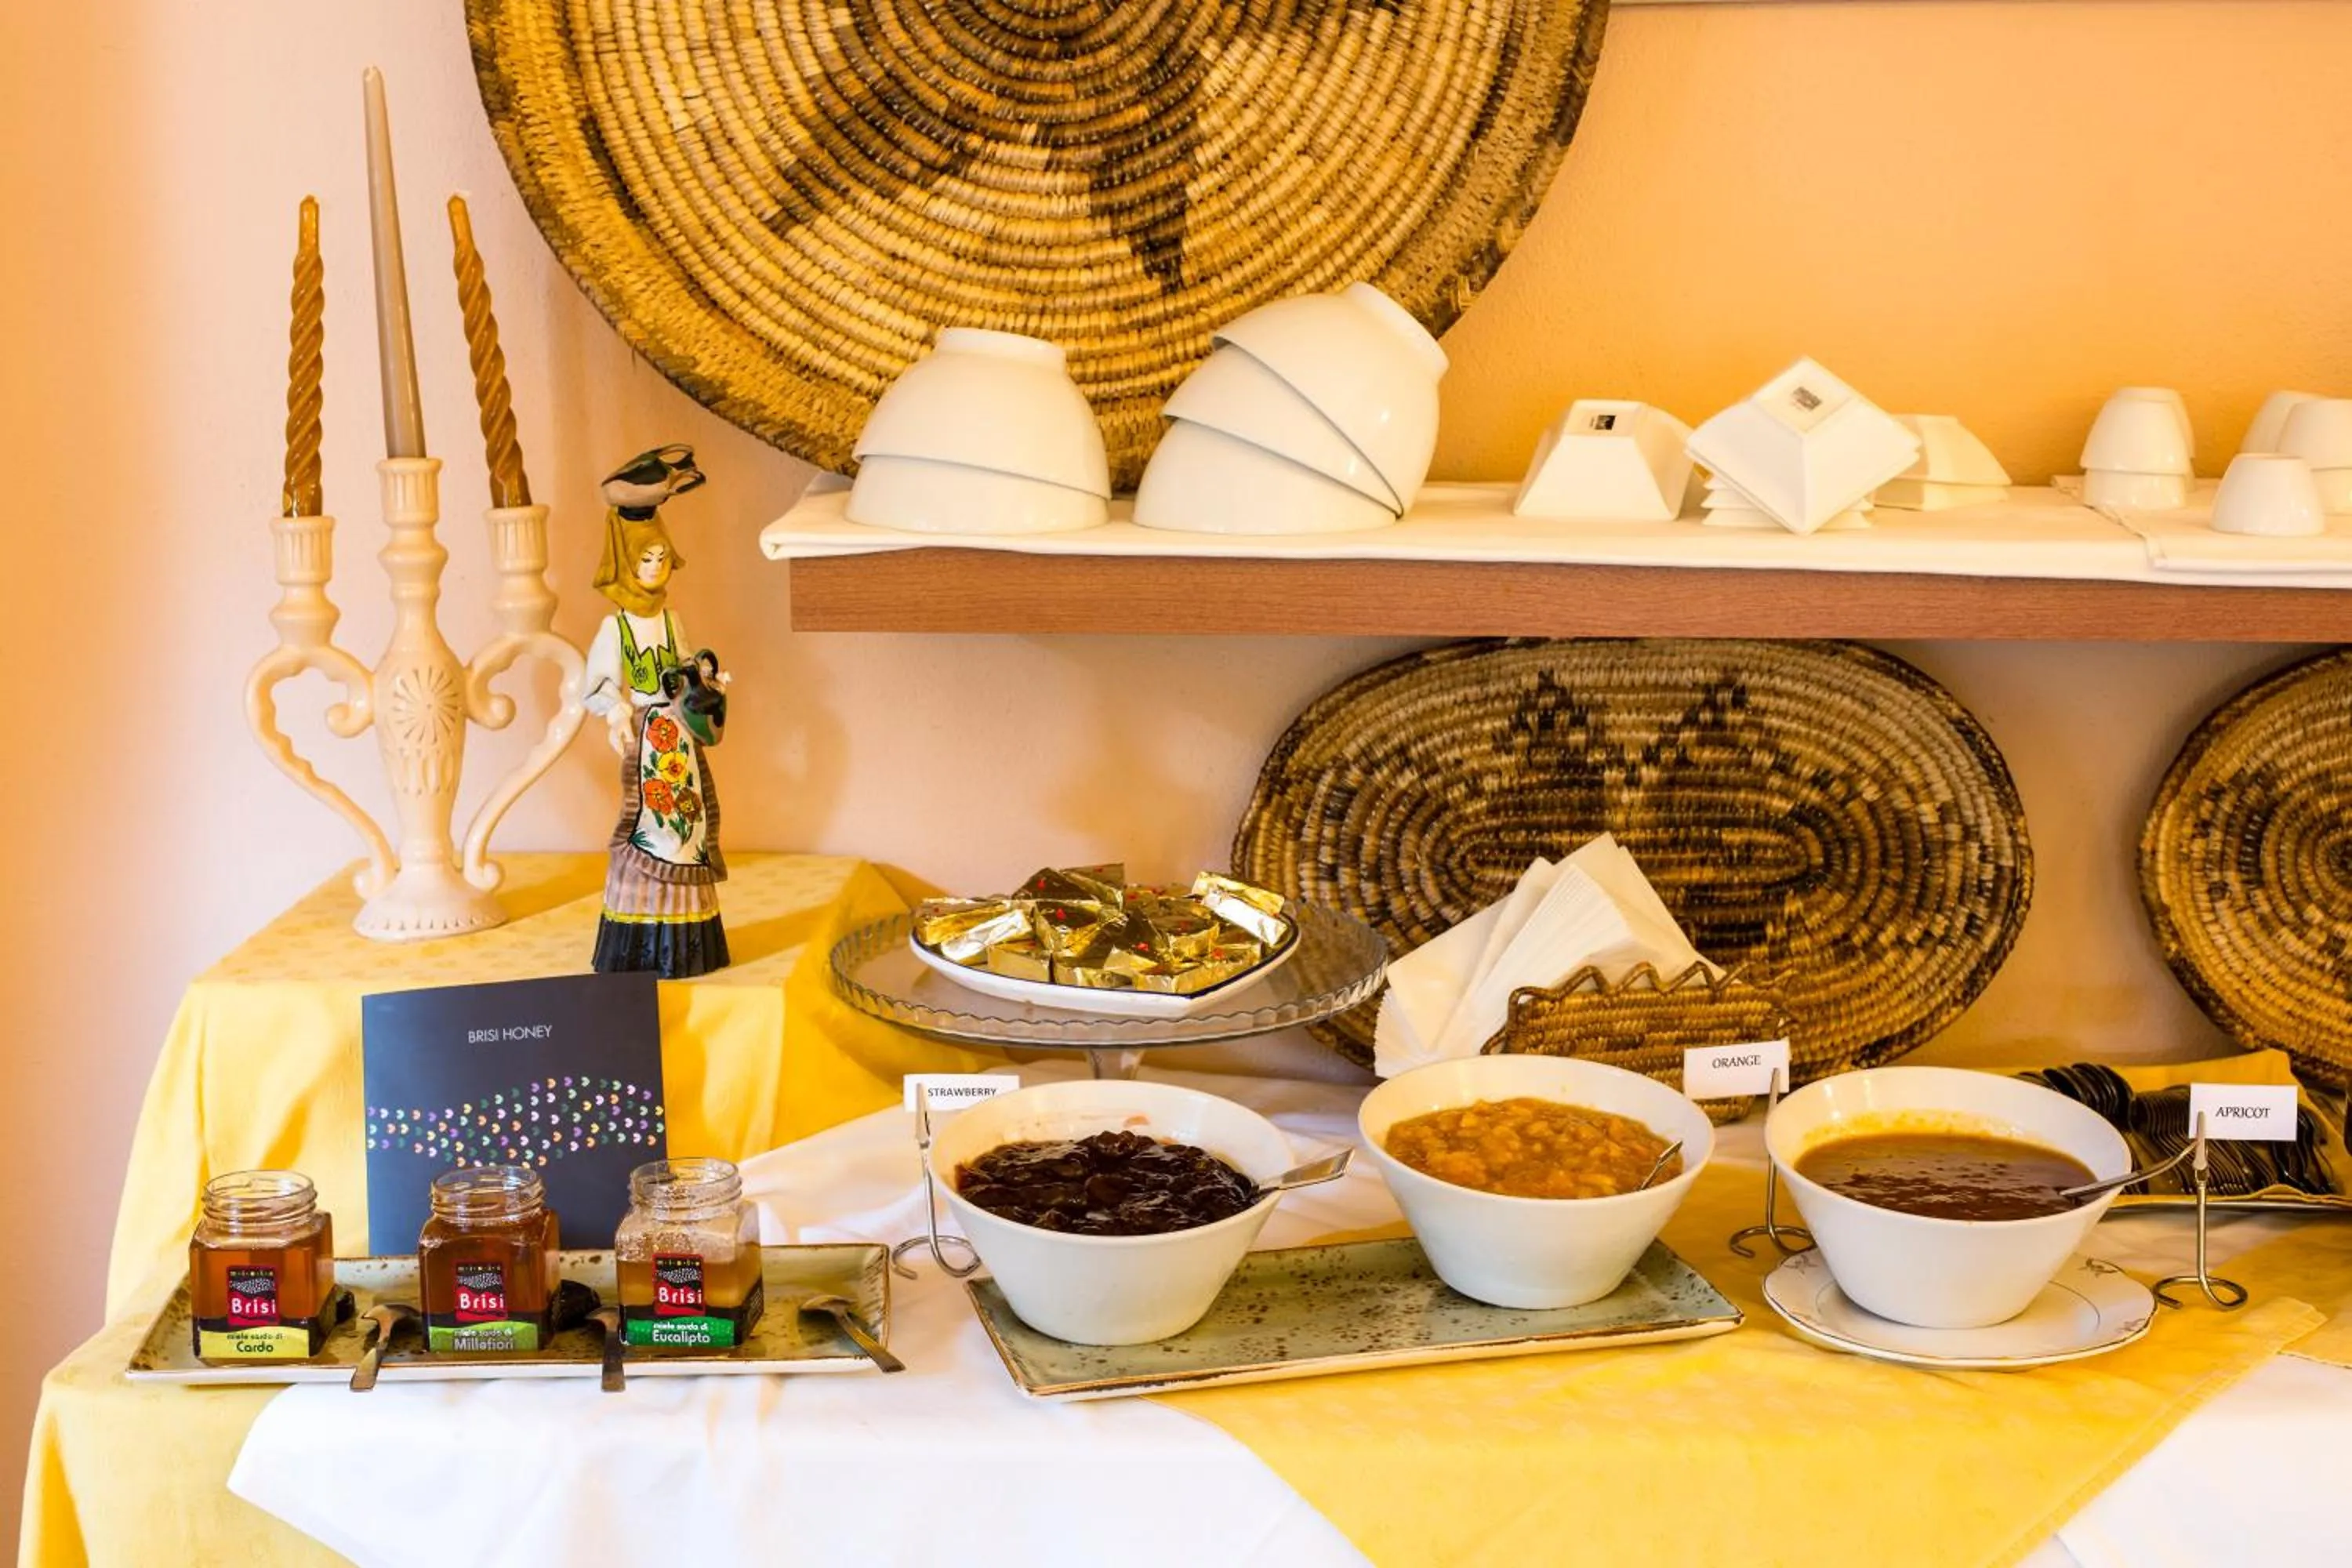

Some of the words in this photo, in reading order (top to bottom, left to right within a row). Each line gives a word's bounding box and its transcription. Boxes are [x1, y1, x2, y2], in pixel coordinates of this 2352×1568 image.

[468, 1028, 499, 1044] BRISI
[503, 1025, 552, 1041] HONEY
[1711, 1054, 1762, 1069] ORANGE
[927, 1087, 997, 1098] STRAWBERRY
[2215, 1106, 2270, 1119] APRICOT
[459, 1293, 504, 1309] Brisi
[659, 1287, 702, 1304] Brisi
[231, 1298, 276, 1314] Brisi
[454, 1337, 514, 1351] Millefiori
[652, 1330, 711, 1346] Eucalipto
[236, 1341, 274, 1352] Cardo
